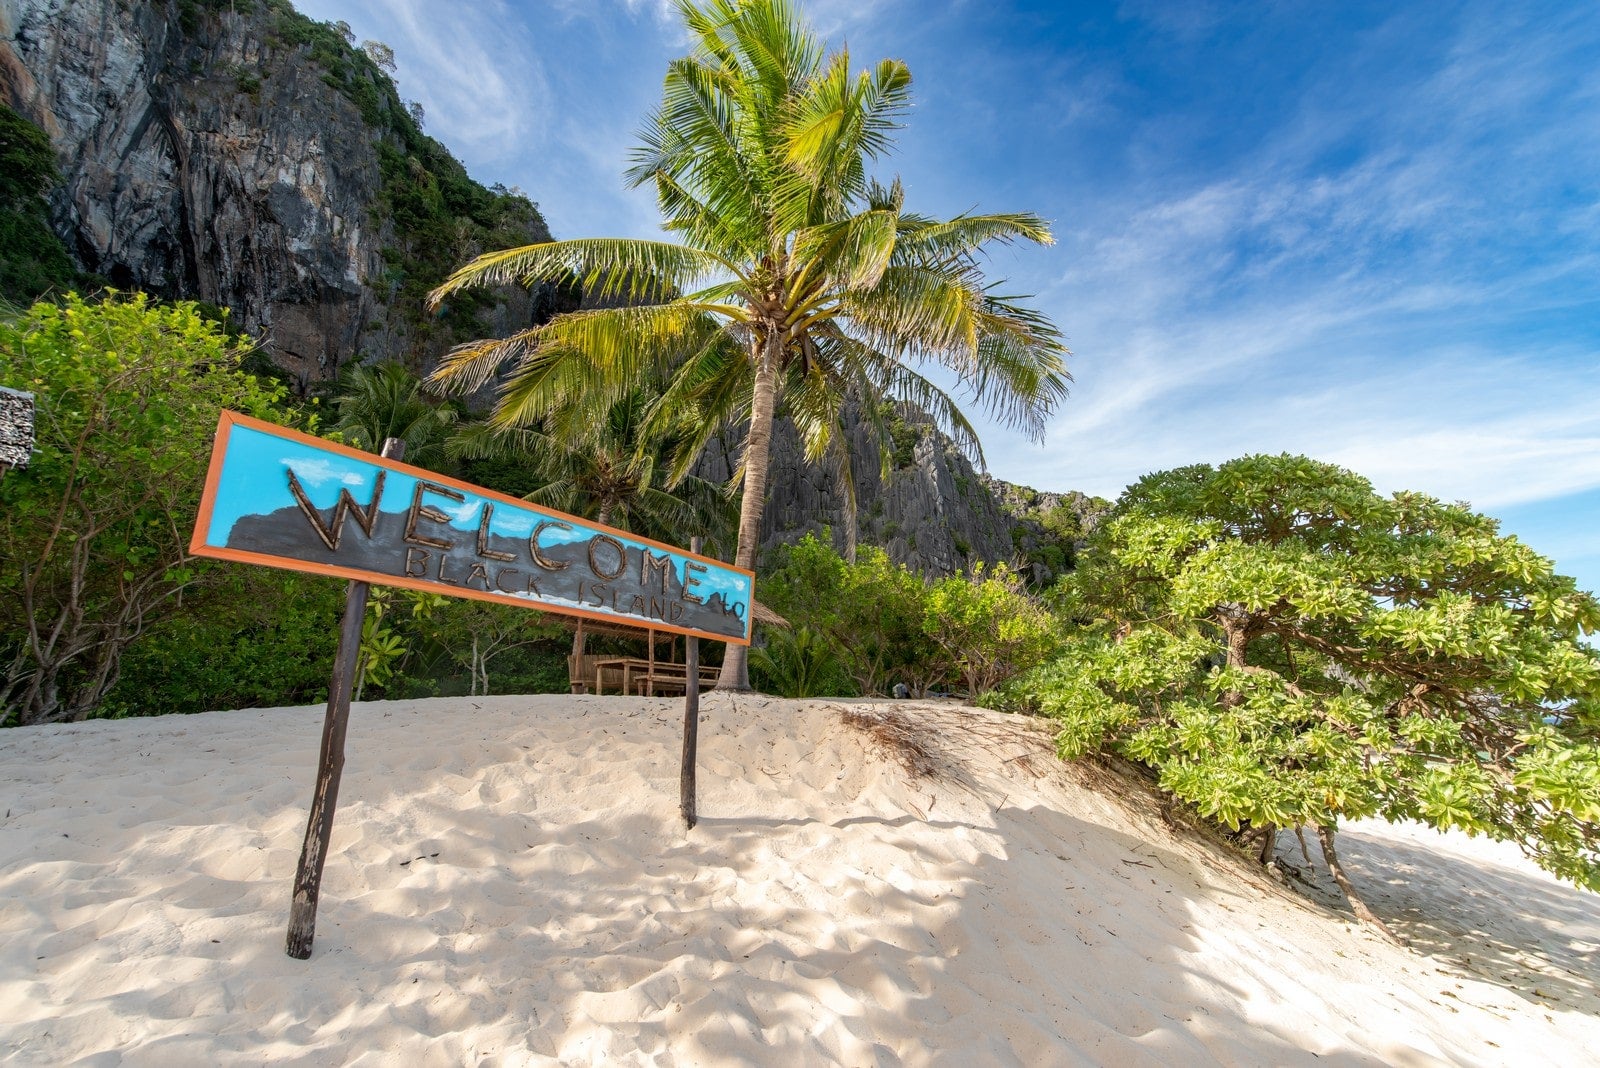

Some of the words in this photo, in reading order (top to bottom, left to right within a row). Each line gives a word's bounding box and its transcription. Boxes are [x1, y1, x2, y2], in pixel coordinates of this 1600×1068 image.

[286, 467, 708, 602] WELCOME
[719, 592, 746, 618] to
[404, 546, 542, 598] BLACK
[578, 581, 686, 622] ISLAND
